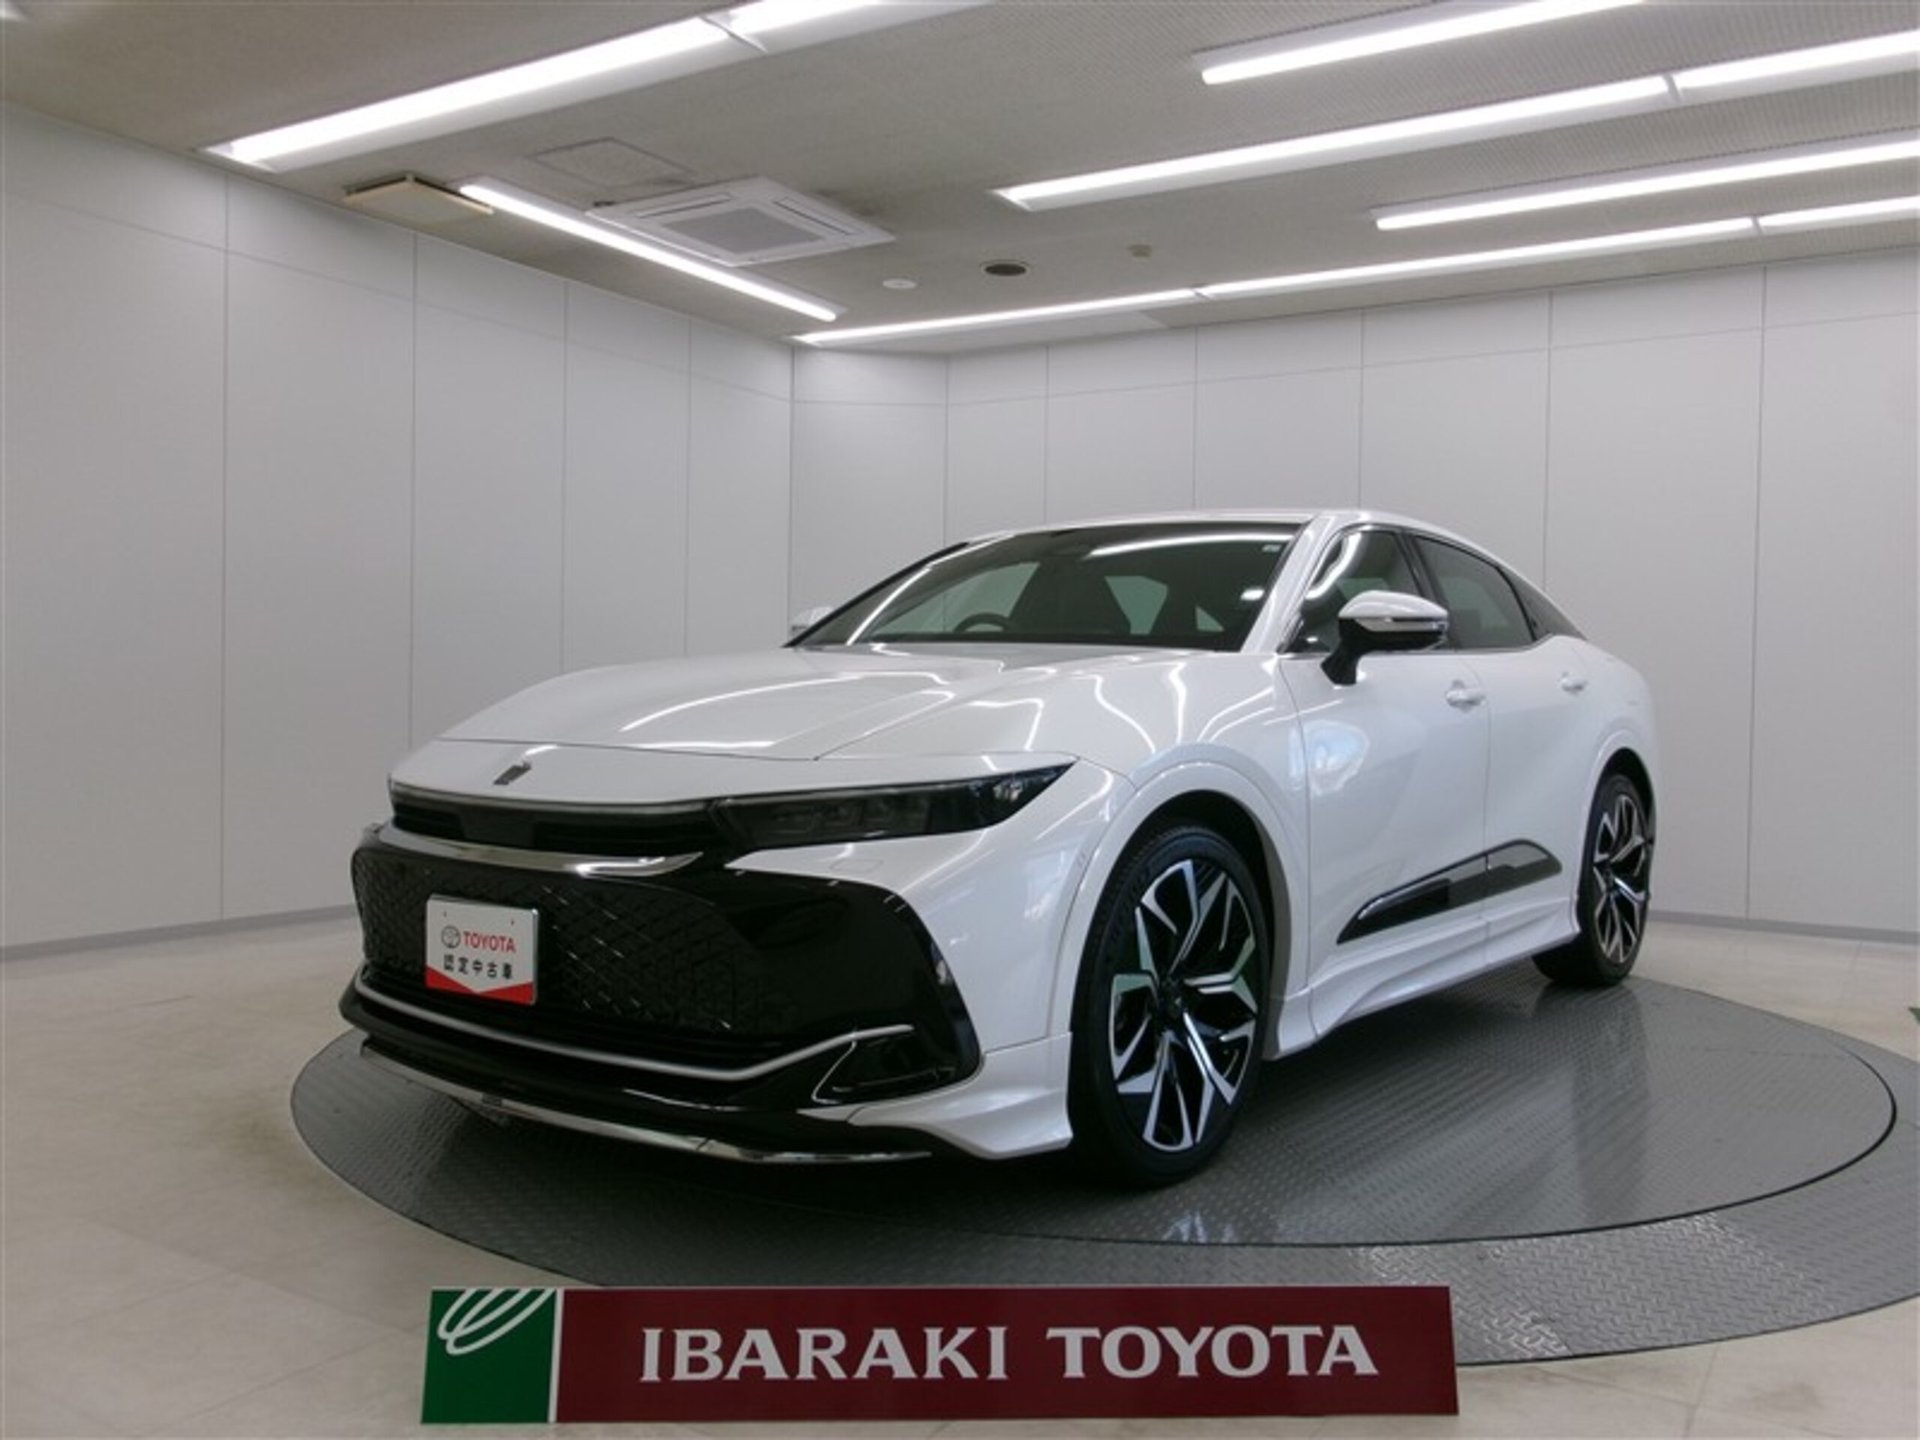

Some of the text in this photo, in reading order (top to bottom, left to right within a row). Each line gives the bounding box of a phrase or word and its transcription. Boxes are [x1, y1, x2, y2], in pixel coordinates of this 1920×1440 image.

[463, 931, 516, 953] TOYOTA
[443, 954, 512, 980] 認定中古車
[640, 1323, 1379, 1382] IBARAKI TOYOTA
